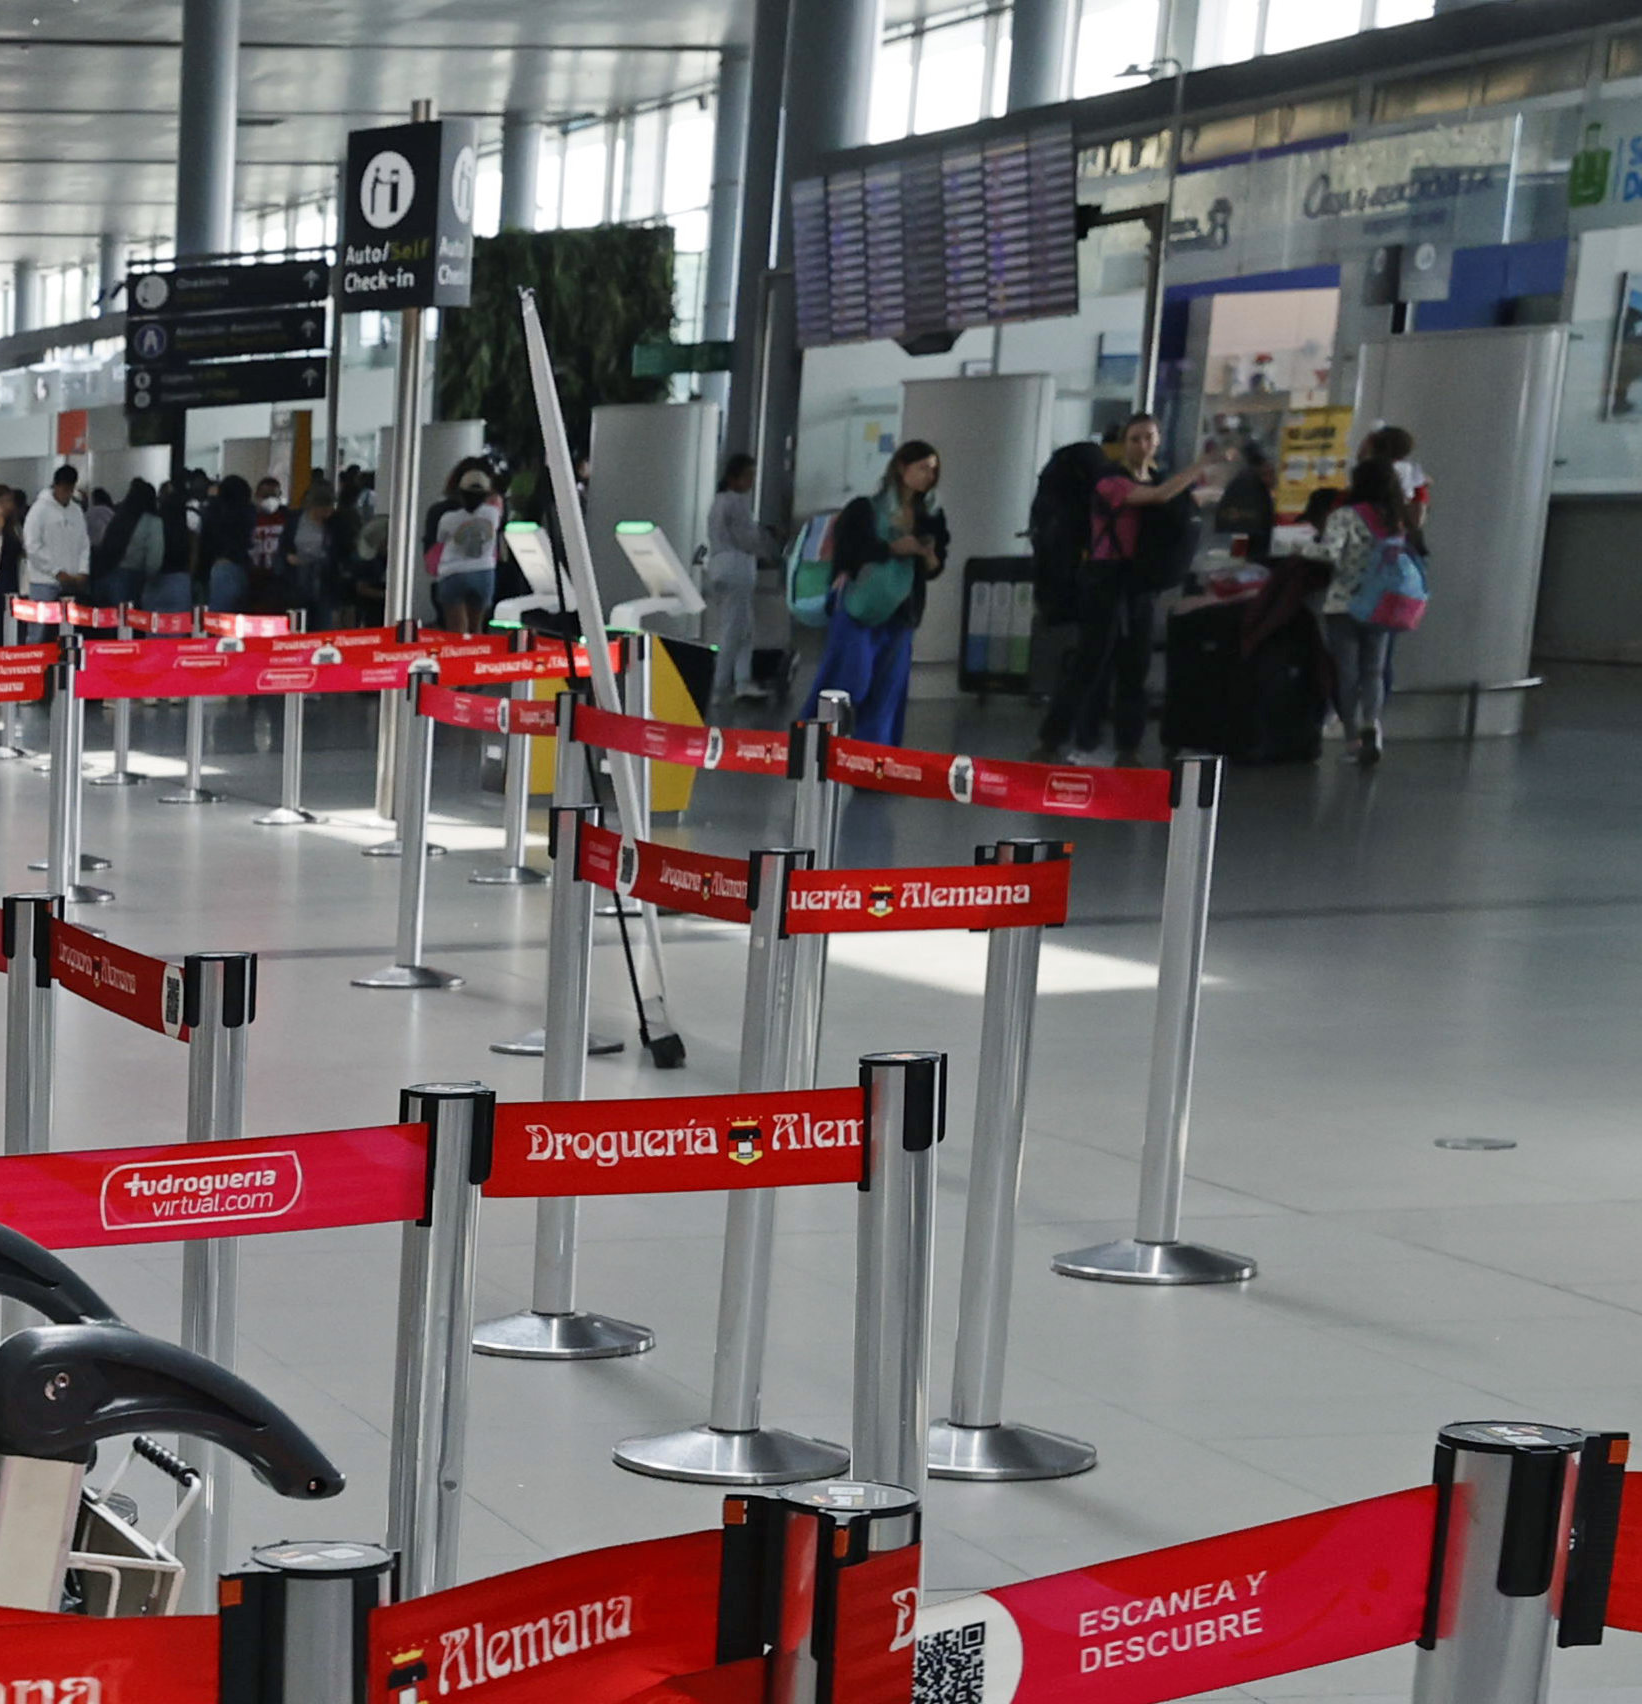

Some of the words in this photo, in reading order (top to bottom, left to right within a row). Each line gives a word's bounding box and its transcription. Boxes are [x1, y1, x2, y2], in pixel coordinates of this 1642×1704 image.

[344, 268, 414, 293] Check-in
[791, 885, 861, 909] uería
[900, 883, 1029, 907] Alemana
[526, 1119, 718, 1166] Droguería
[772, 1113, 863, 1150] Alem
[151, 1189, 275, 1221] virtual.com
[1080, 1580, 1237, 1639] ESCANEA
[1247, 1571, 1266, 1596] Y
[439, 1596, 631, 1695] Alemana
[1080, 1605, 1262, 1672] DESCUBRE
